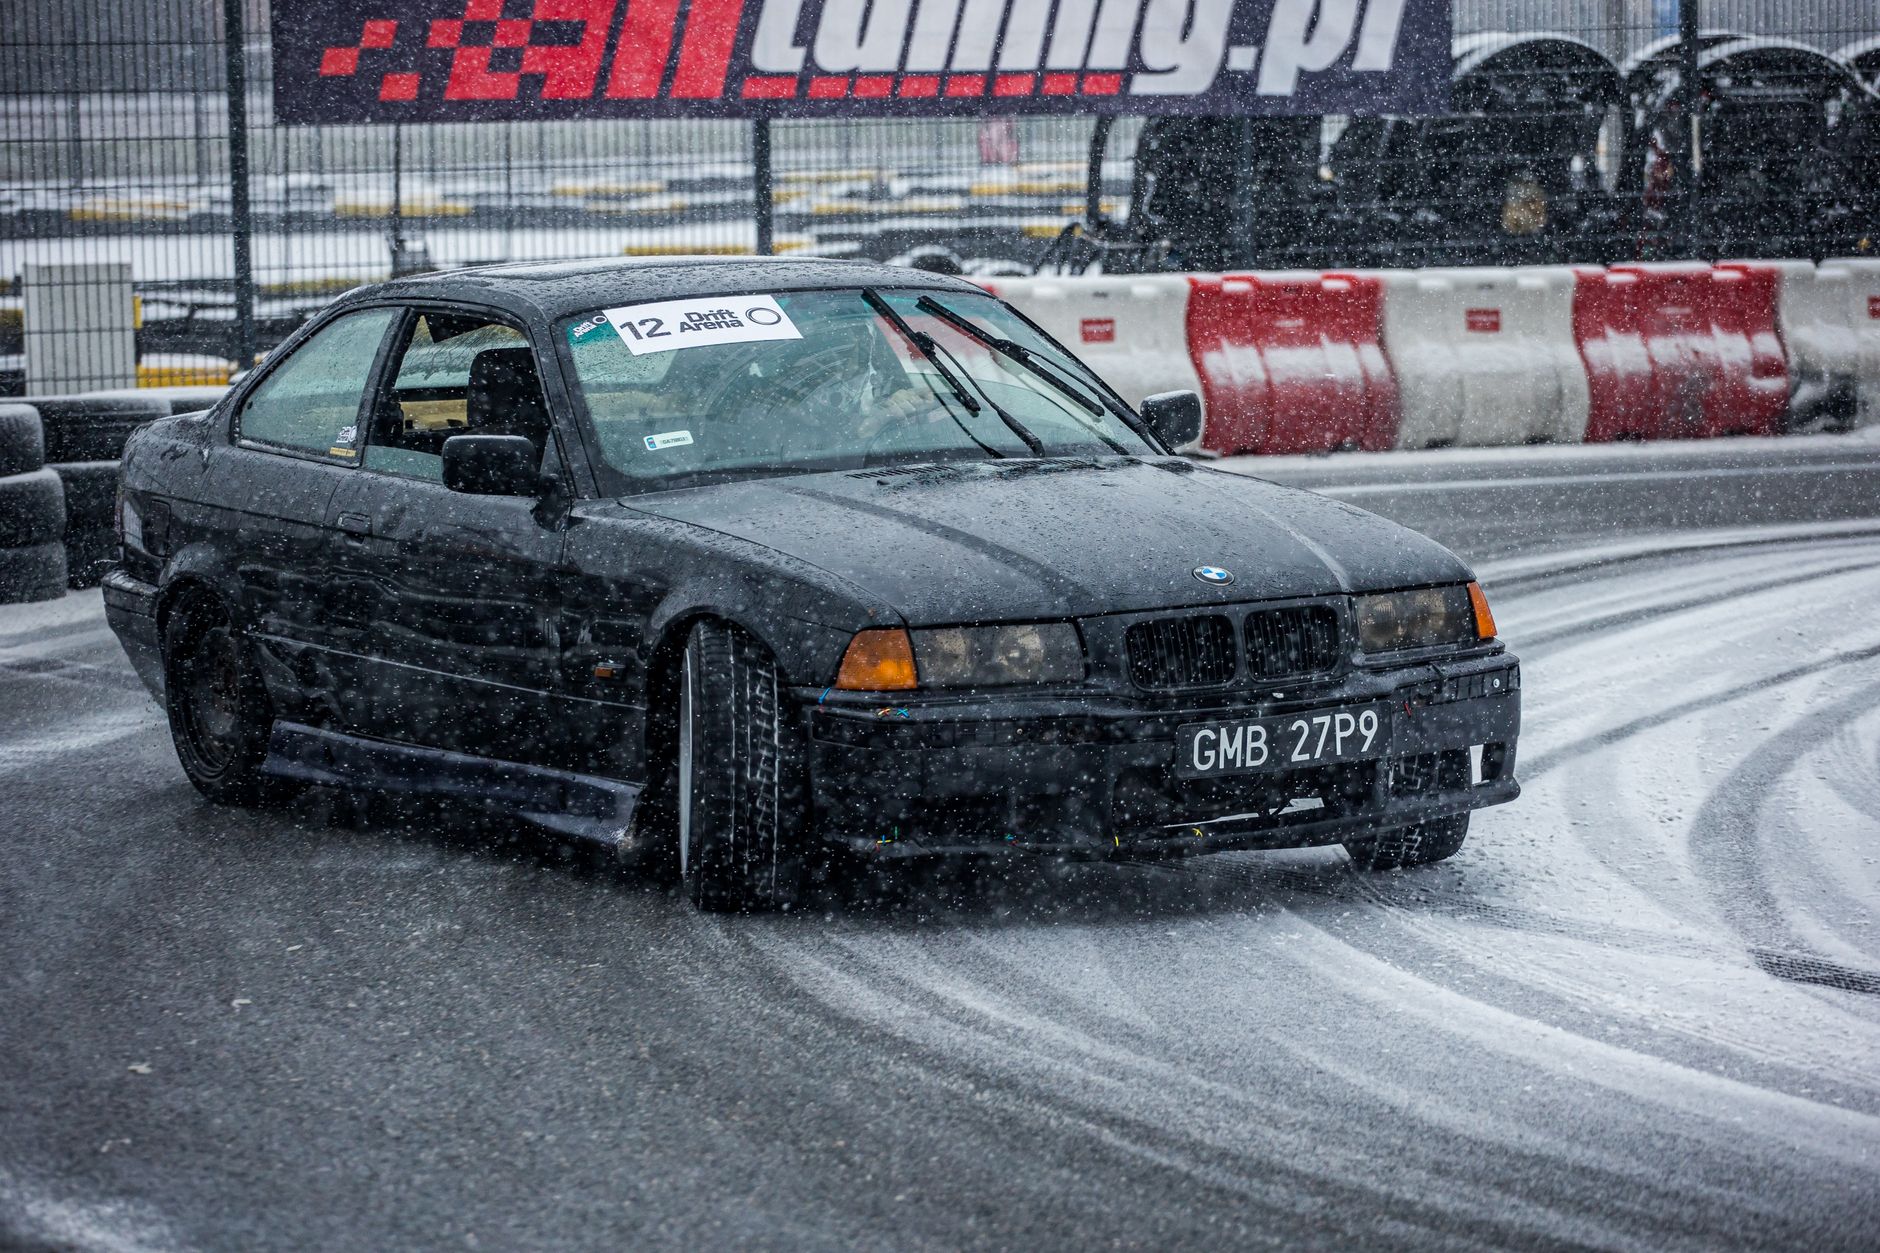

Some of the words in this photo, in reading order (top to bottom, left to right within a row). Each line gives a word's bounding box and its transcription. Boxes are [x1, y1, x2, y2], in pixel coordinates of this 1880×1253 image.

[684, 309, 738, 323] Drift
[619, 317, 672, 341] 12
[680, 319, 744, 333] Arena
[1193, 725, 1268, 771] GMB
[1291, 710, 1379, 763] 27P9
